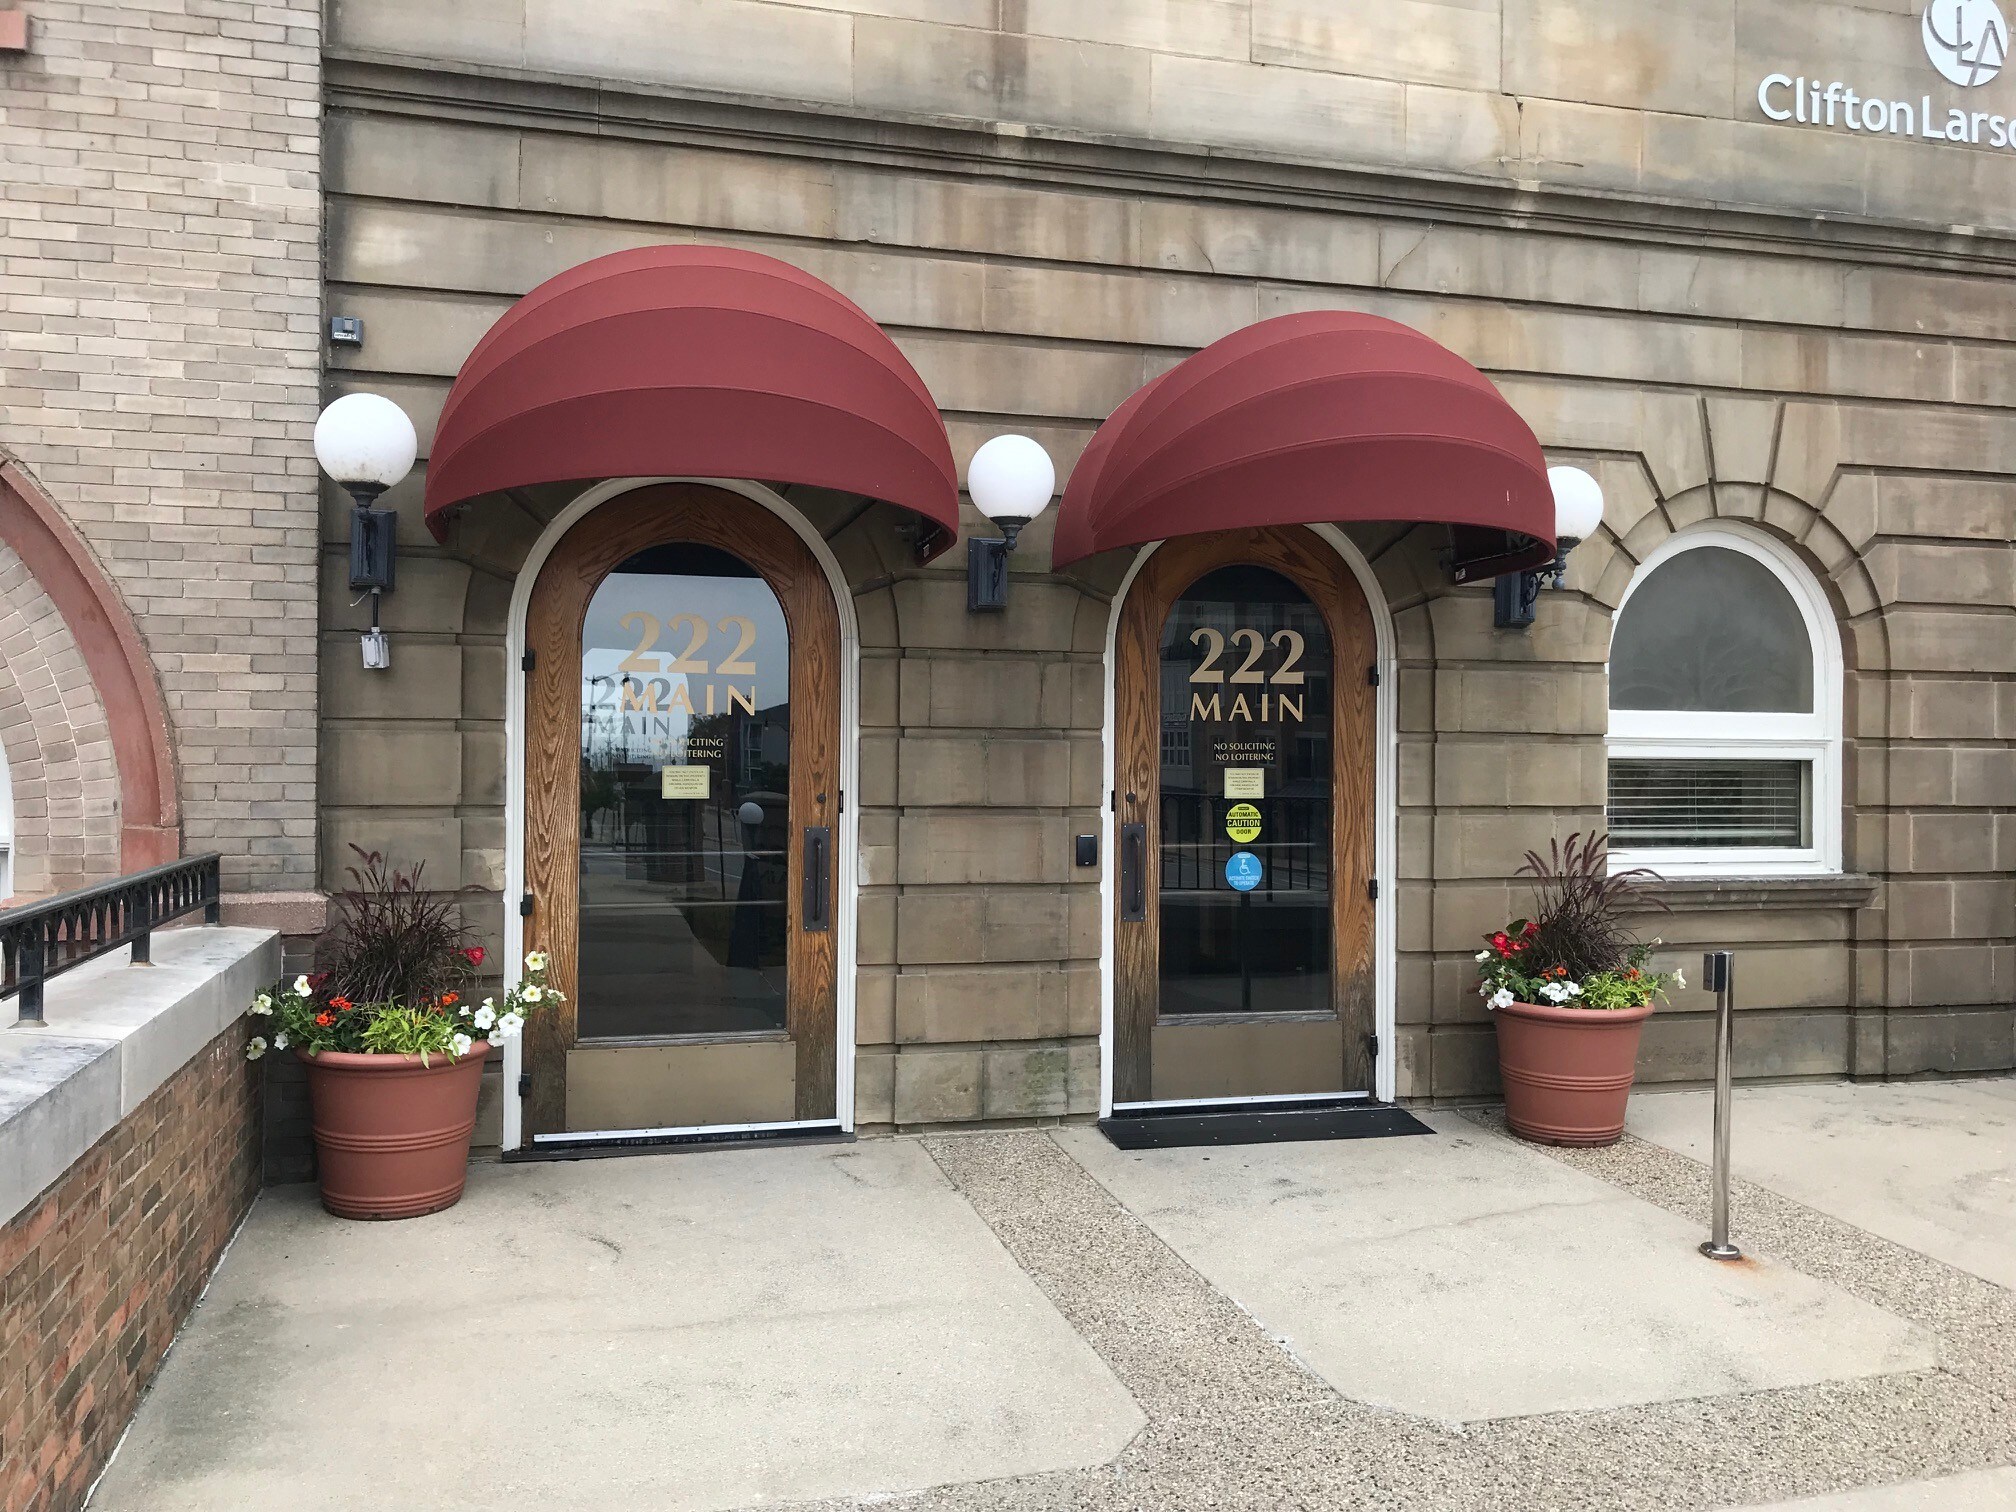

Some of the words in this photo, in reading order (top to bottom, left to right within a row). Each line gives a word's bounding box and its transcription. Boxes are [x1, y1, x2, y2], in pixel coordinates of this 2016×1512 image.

[618, 611, 756, 675] 222
[1189, 628, 1305, 684] 222
[620, 682, 756, 717] MAIN
[1190, 692, 1303, 723] MAIN
[668, 738, 724, 747] ICITING
[1213, 742, 1228, 751] NO
[1229, 742, 1276, 751] SOLICITING
[1215, 753, 1229, 761] NO
[1231, 753, 1274, 761] LOITERING
[1227, 819, 1260, 827] CAUTION
